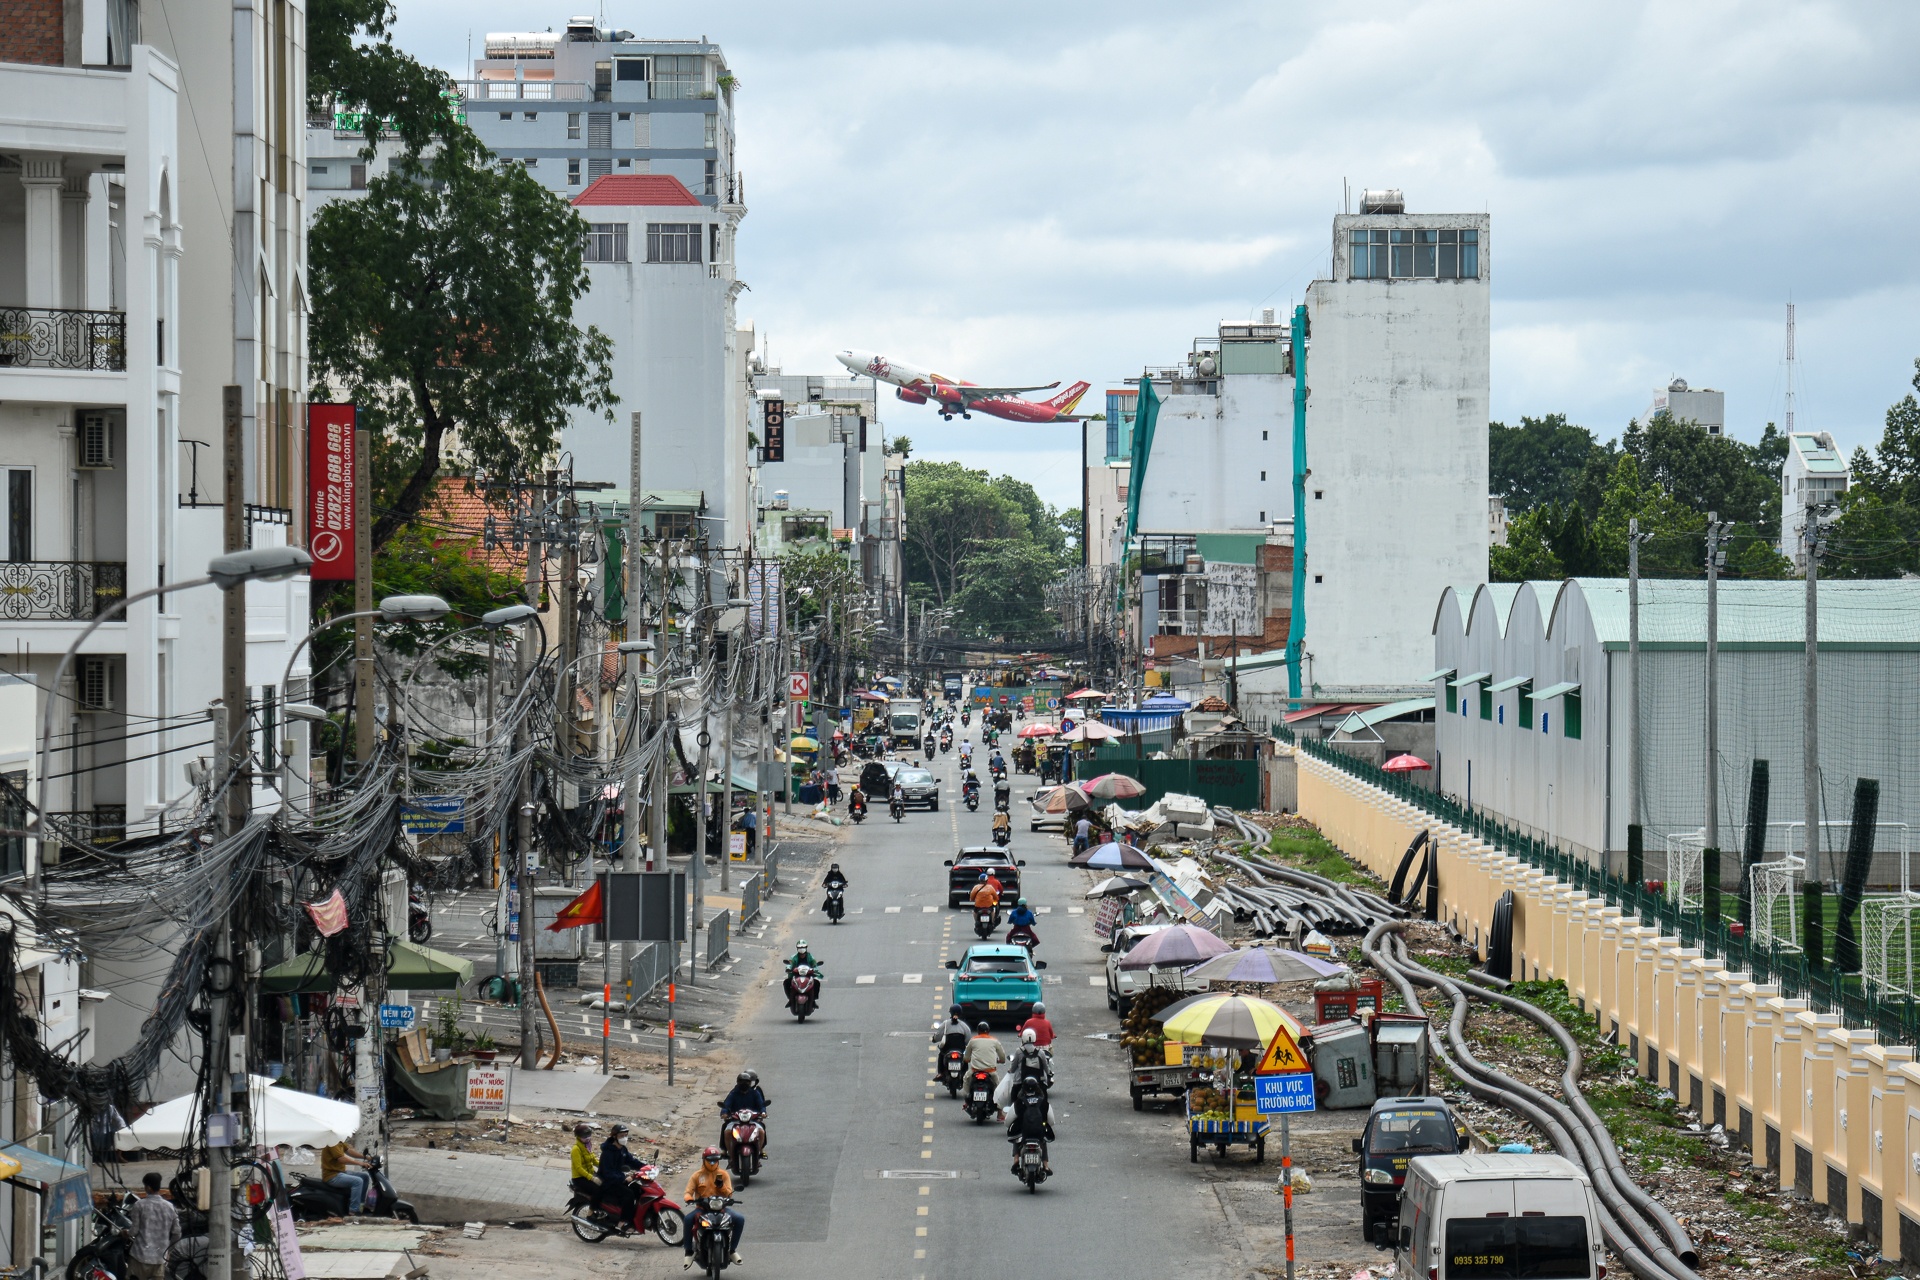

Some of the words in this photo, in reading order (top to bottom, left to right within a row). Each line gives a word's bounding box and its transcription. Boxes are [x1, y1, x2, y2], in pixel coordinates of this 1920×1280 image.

[327, 423, 342, 452] 688
[767, 402, 782, 459] HOTEL
[327, 453, 342, 483] 688
[342, 423, 353, 530] www.kingbbq.com.vn
[315, 490, 325, 528] Hotline
[327, 484, 342, 531] 02822
[400, 1010, 412, 1018] 127
[469, 1085, 484, 1099] ÁNH
[486, 1086, 504, 1100] SÁNG
[489, 1078, 504, 1086] NƯỚC
[1265, 1082, 1283, 1094] KHU
[1286, 1080, 1303, 1094] VỰC
[1259, 1094, 1294, 1109] TRƯỜNG
[1295, 1094, 1312, 1108] HỌC
[1454, 1256, 1472, 1265] 0935
[1474, 1256, 1488, 1265] 325
[1490, 1255, 1504, 1264] 790
